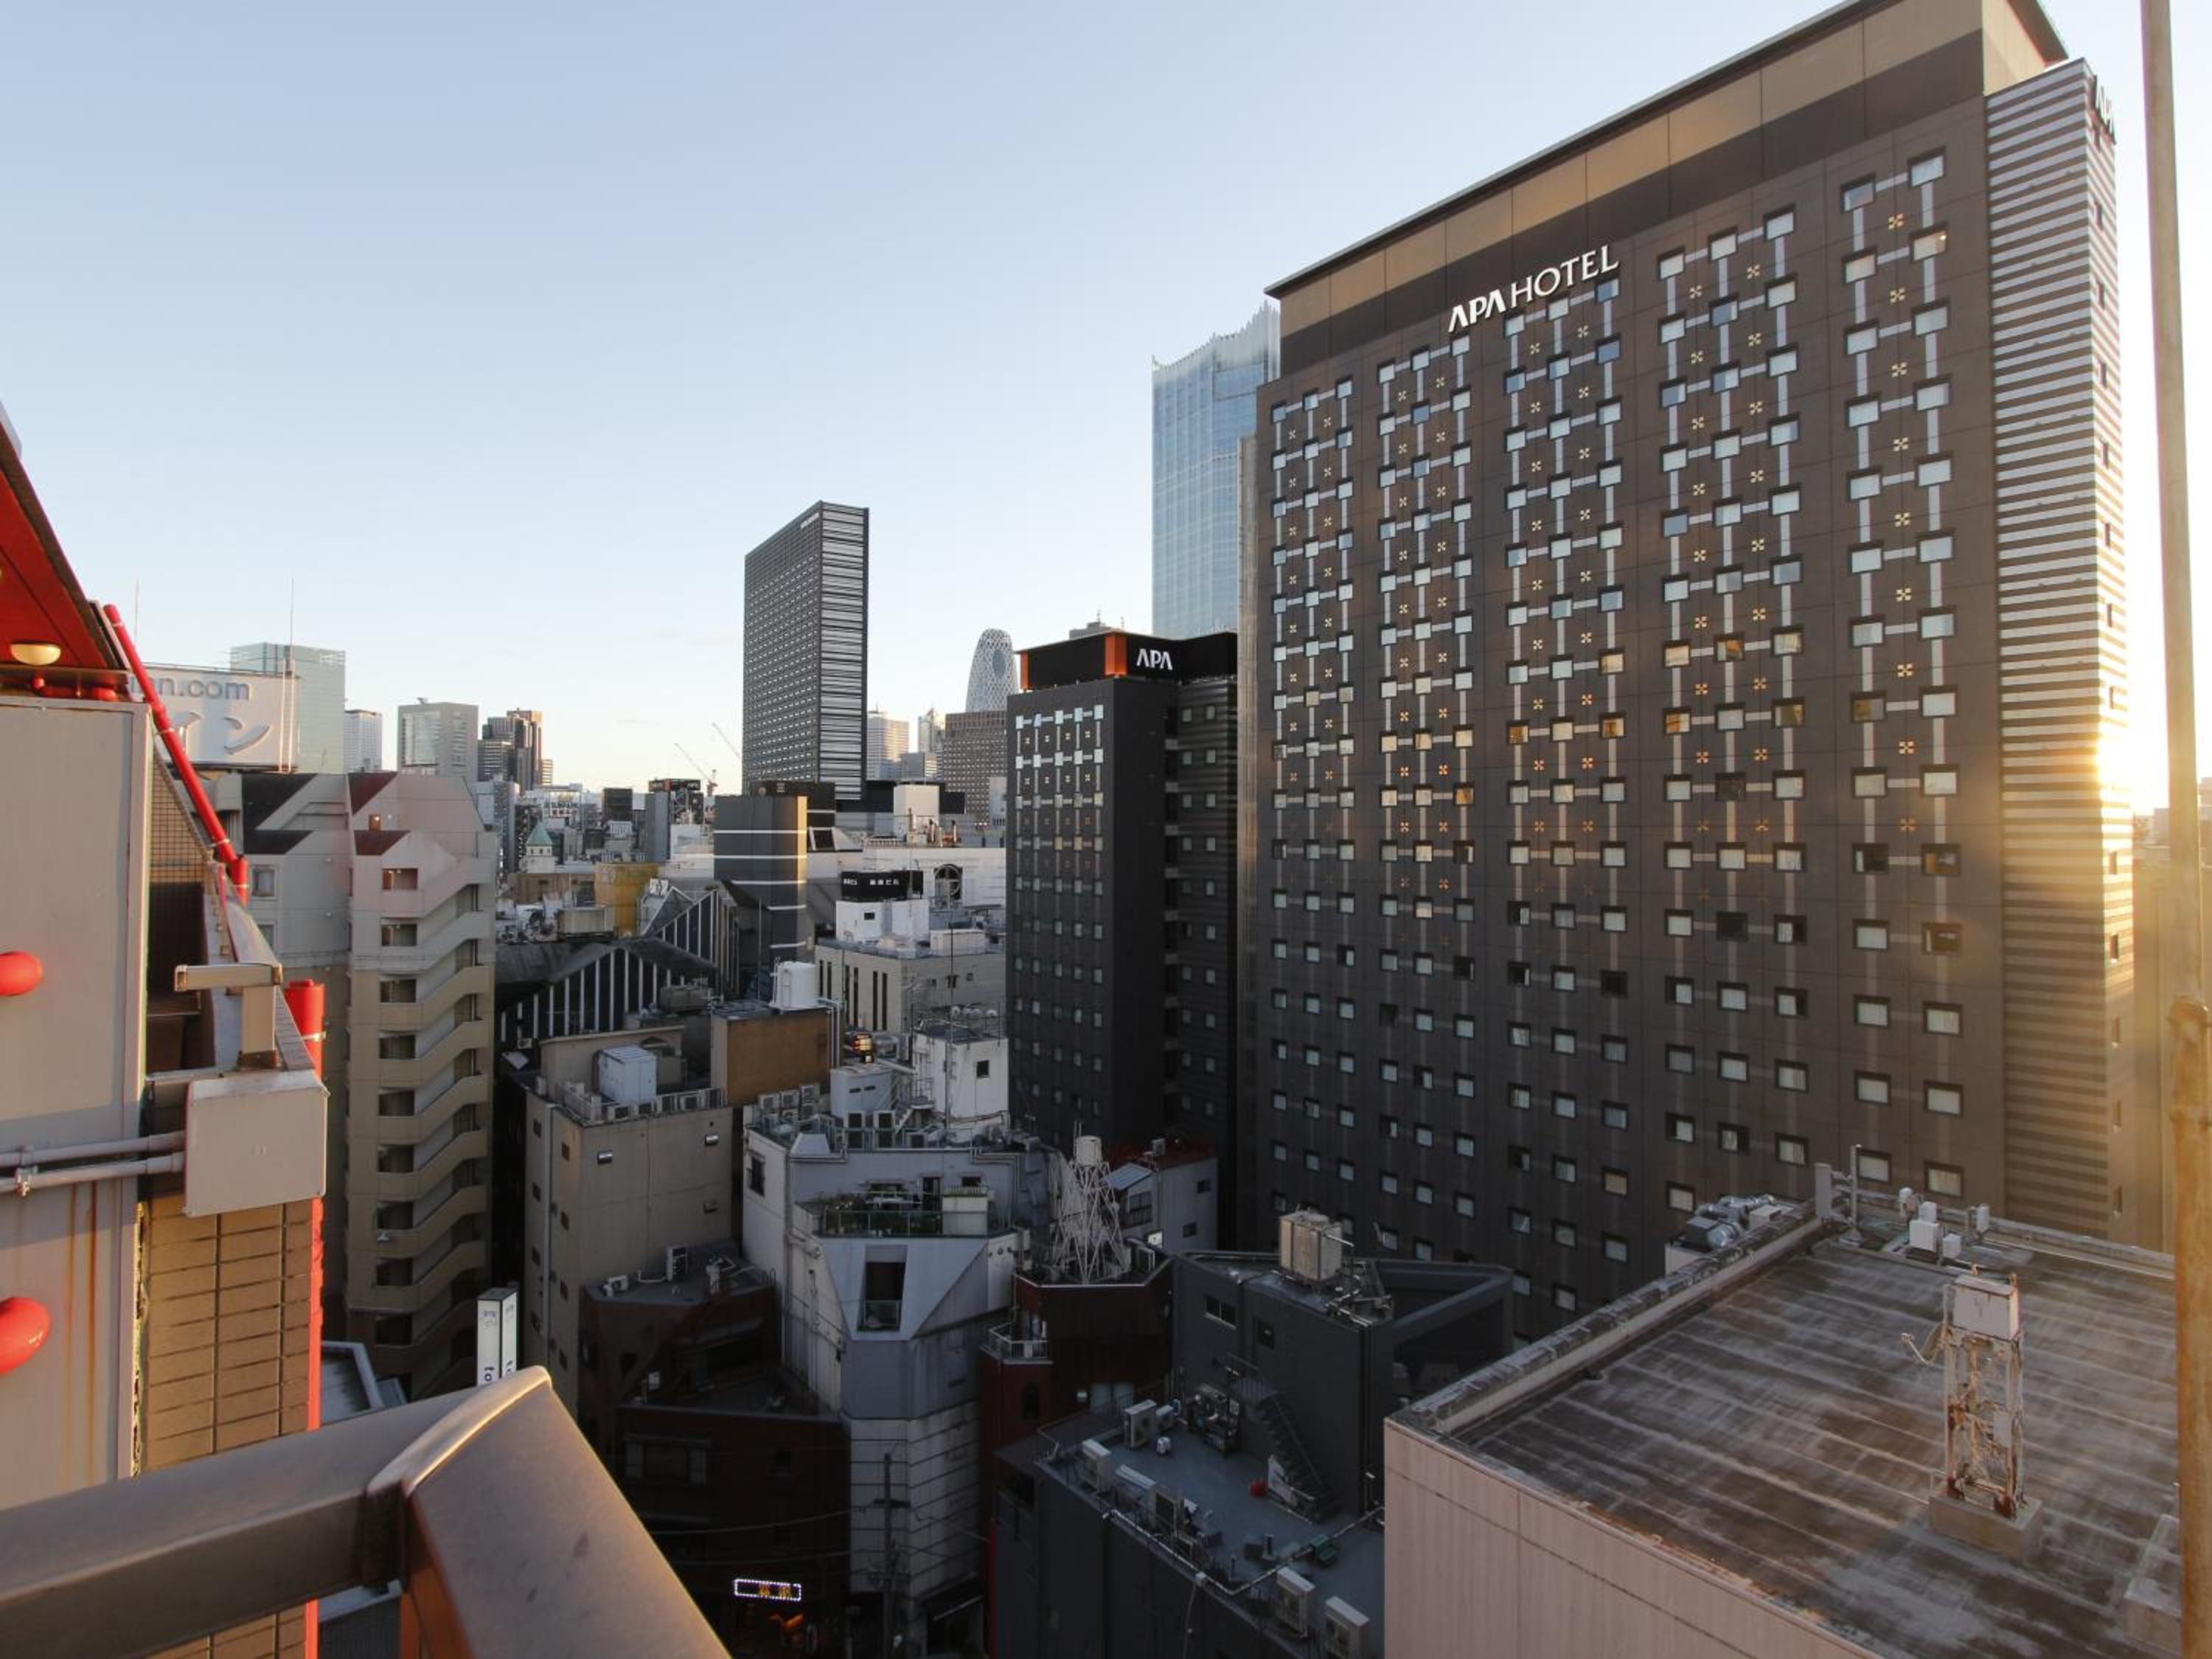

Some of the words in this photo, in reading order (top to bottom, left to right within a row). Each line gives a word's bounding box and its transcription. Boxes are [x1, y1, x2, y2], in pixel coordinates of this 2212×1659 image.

[1447, 289, 1506, 333] APA
[1510, 244, 1620, 308] HOTEL
[1135, 647, 1174, 671] APA
